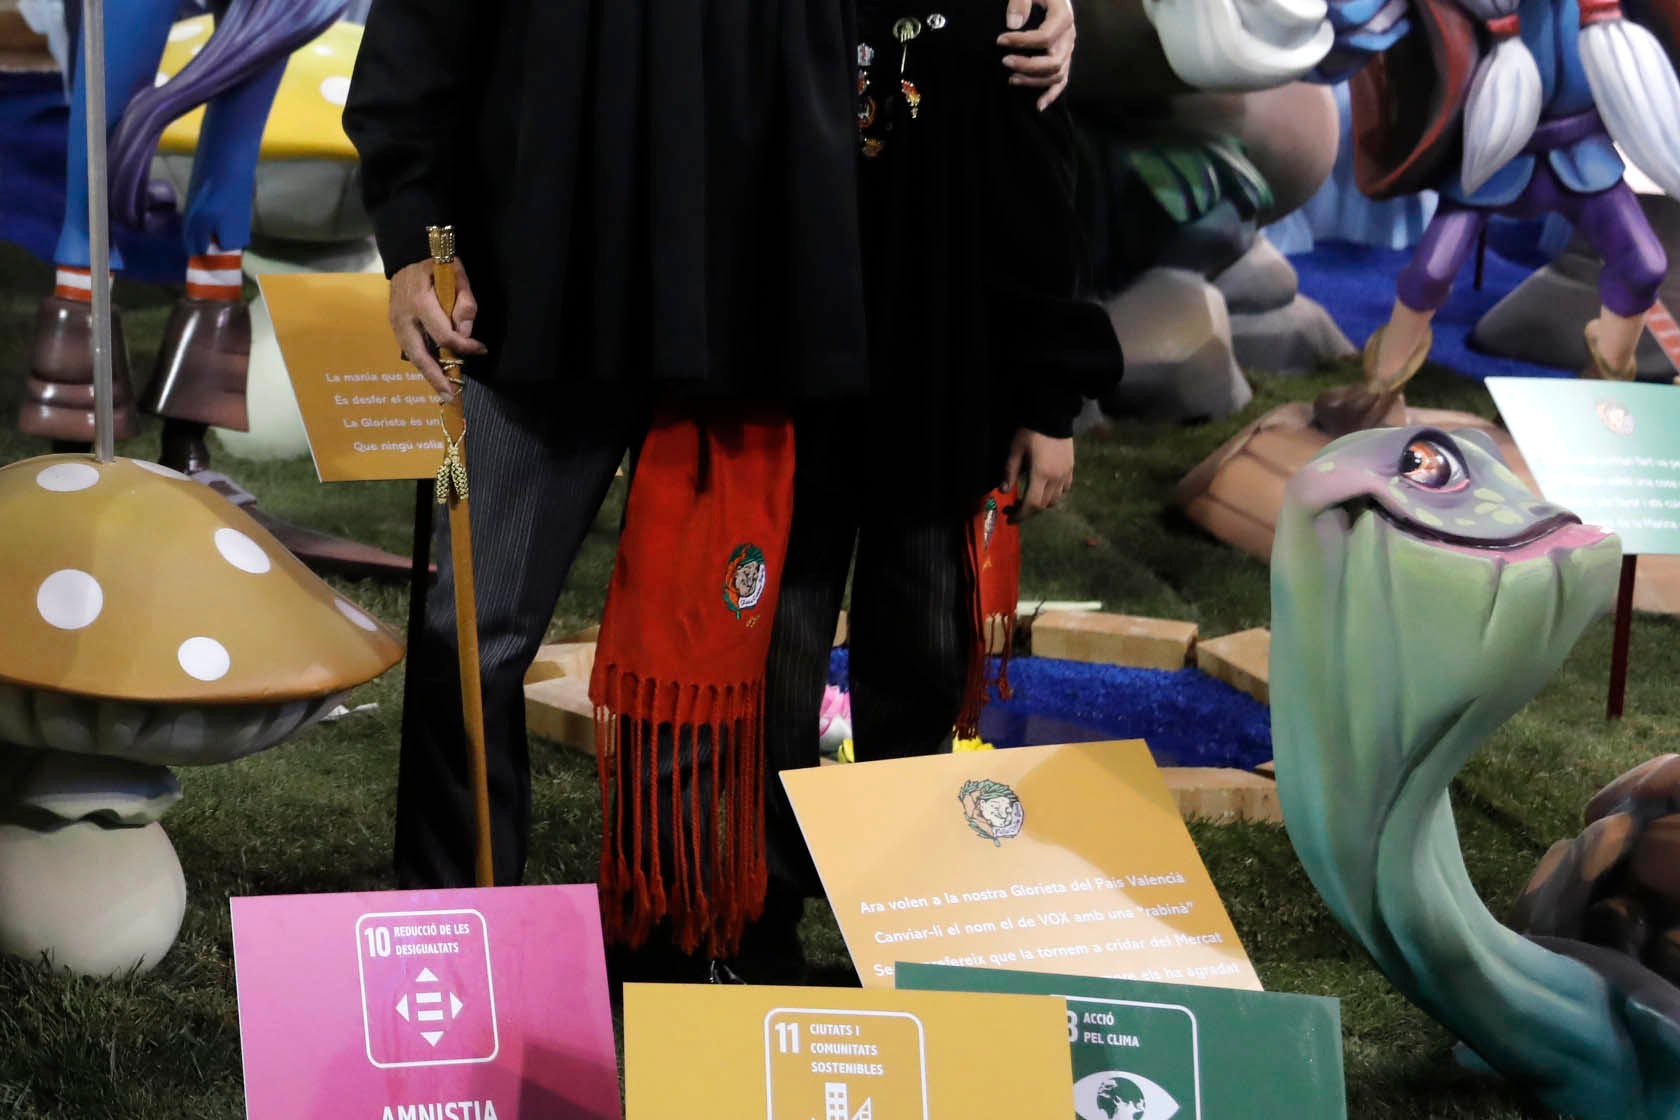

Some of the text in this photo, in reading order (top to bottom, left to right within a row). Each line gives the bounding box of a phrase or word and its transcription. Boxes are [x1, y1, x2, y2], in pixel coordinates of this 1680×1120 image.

[353, 441, 379, 453] Que
[860, 900, 886, 914] Ara
[888, 896, 929, 911] volen
[932, 895, 942, 906] a
[944, 892, 960, 904] la
[963, 888, 1009, 903] nostra
[1010, 881, 1067, 898] Glorieta
[1071, 879, 1092, 893] del
[393, 923, 470, 937] REDUCCIÓ DE LES
[874, 924, 944, 945] Canviar-li
[947, 922, 961, 937] el
[964, 921, 997, 935] nom
[1000, 916, 1014, 931] el
[1017, 915, 1036, 930] de
[1038, 911, 1070, 927] VOX
[1074, 908, 1105, 924] amb
[1107, 908, 1135, 921] una
[364, 926, 391, 957] 10
[395, 942, 459, 956] DESIGUALTATS
[989, 951, 1017, 967] que
[1020, 948, 1035, 961] la
[1037, 943, 1089, 959] tornem
[1150, 934, 1172, 949] del
[1174, 931, 1224, 947] Mercat
[1083, 1011, 1115, 1026] ACCIÓ
[809, 1023, 853, 1036] CIUTATS
[775, 1022, 799, 1054] 11
[1083, 1032, 1140, 1048] PEL CLIMA
[810, 1042, 878, 1056] COMUNITATS
[811, 1061, 885, 1076] SOSTENIBLES
